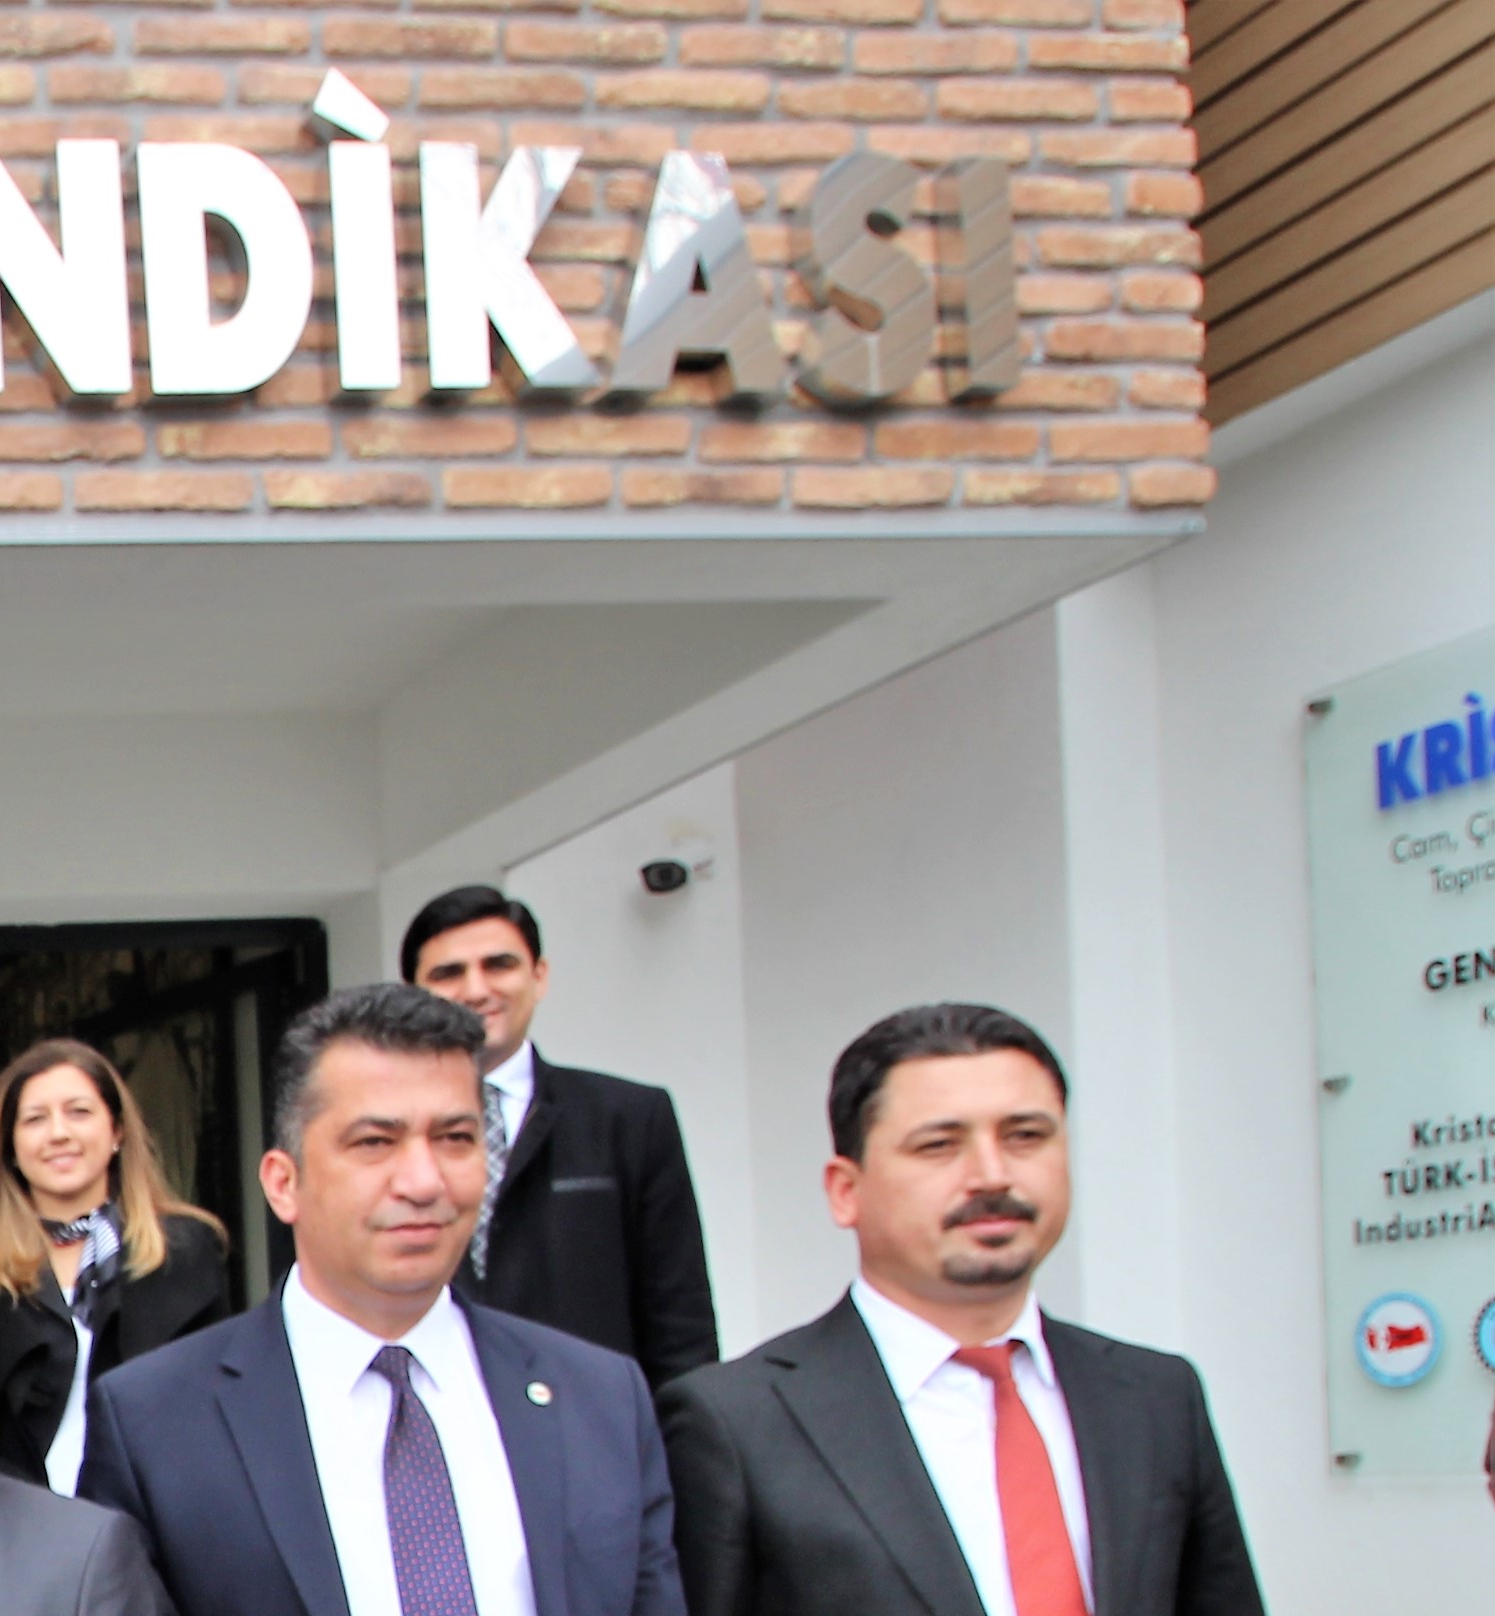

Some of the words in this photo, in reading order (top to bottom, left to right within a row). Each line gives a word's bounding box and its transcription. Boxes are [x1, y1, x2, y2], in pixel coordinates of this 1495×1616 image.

[1375, 691, 1495, 811] KRİ
[1391, 830, 1458, 864] Cam,
[1466, 810, 1495, 848] Ç
[1382, 1146, 1495, 1198] TÜRK-İ
